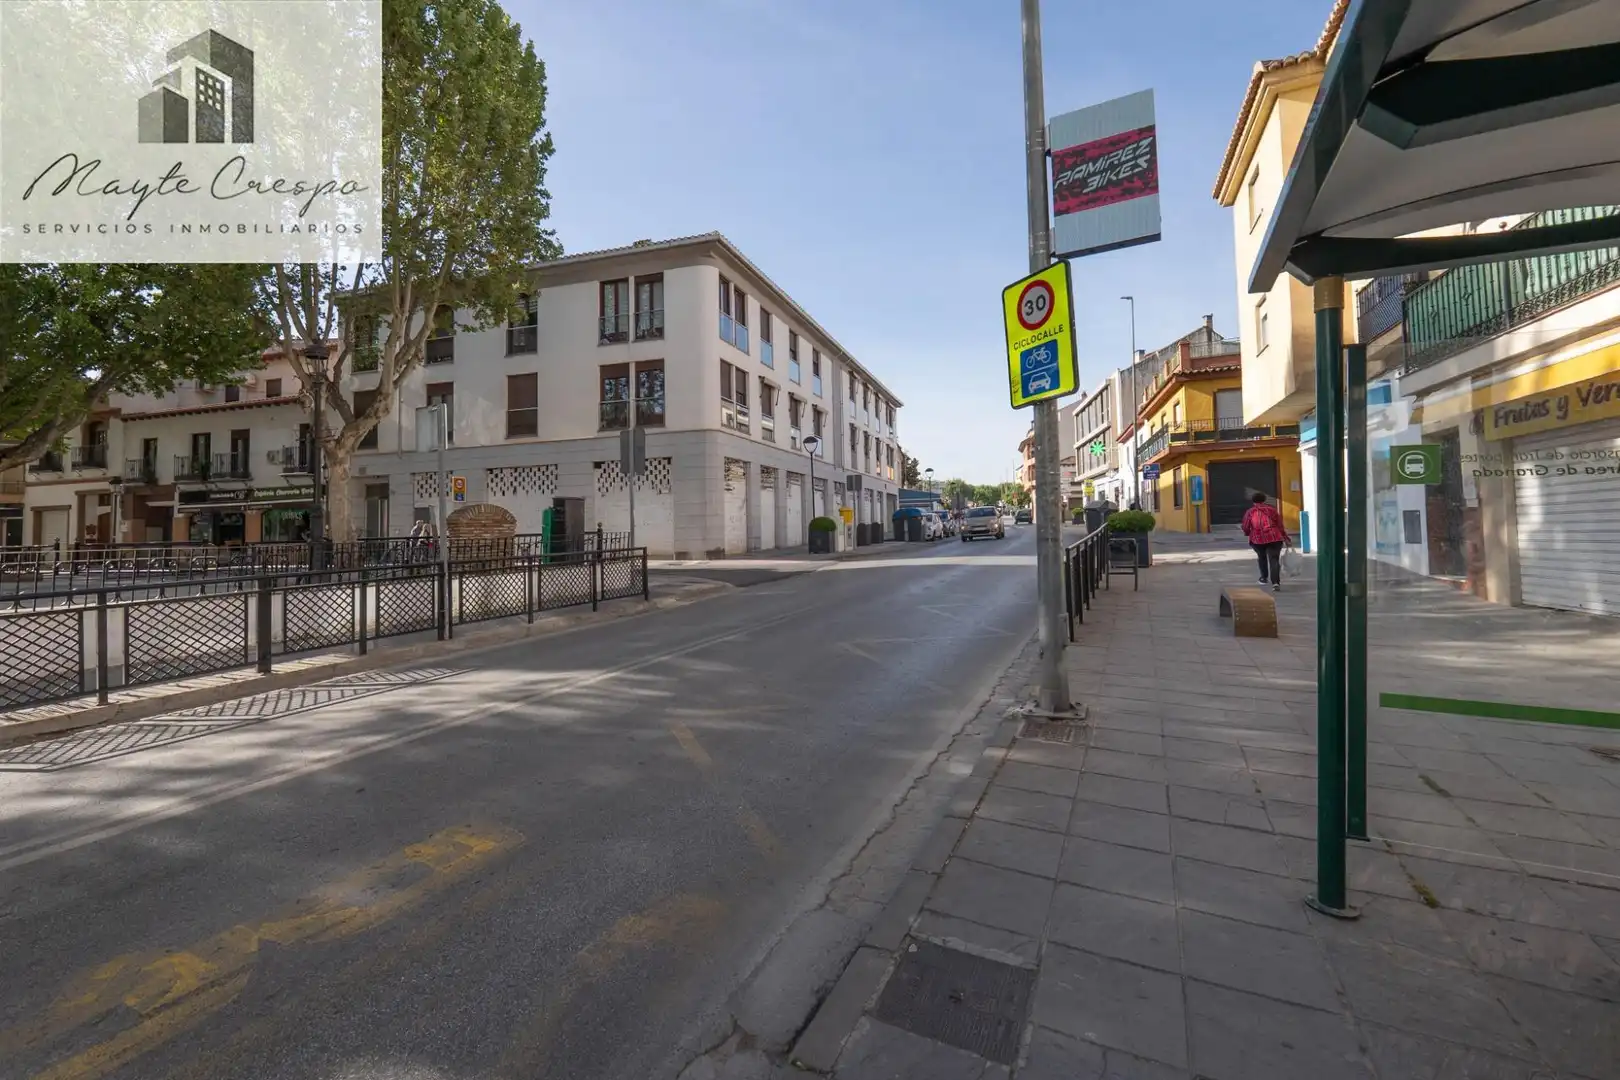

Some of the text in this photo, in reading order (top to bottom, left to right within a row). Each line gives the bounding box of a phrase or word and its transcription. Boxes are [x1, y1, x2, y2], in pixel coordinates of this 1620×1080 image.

[1024, 294, 1046, 316] 30
[1013, 324, 1064, 350] CICLOCALLE
[1494, 399, 1550, 428] Frutas
[1556, 395, 1569, 420] y
